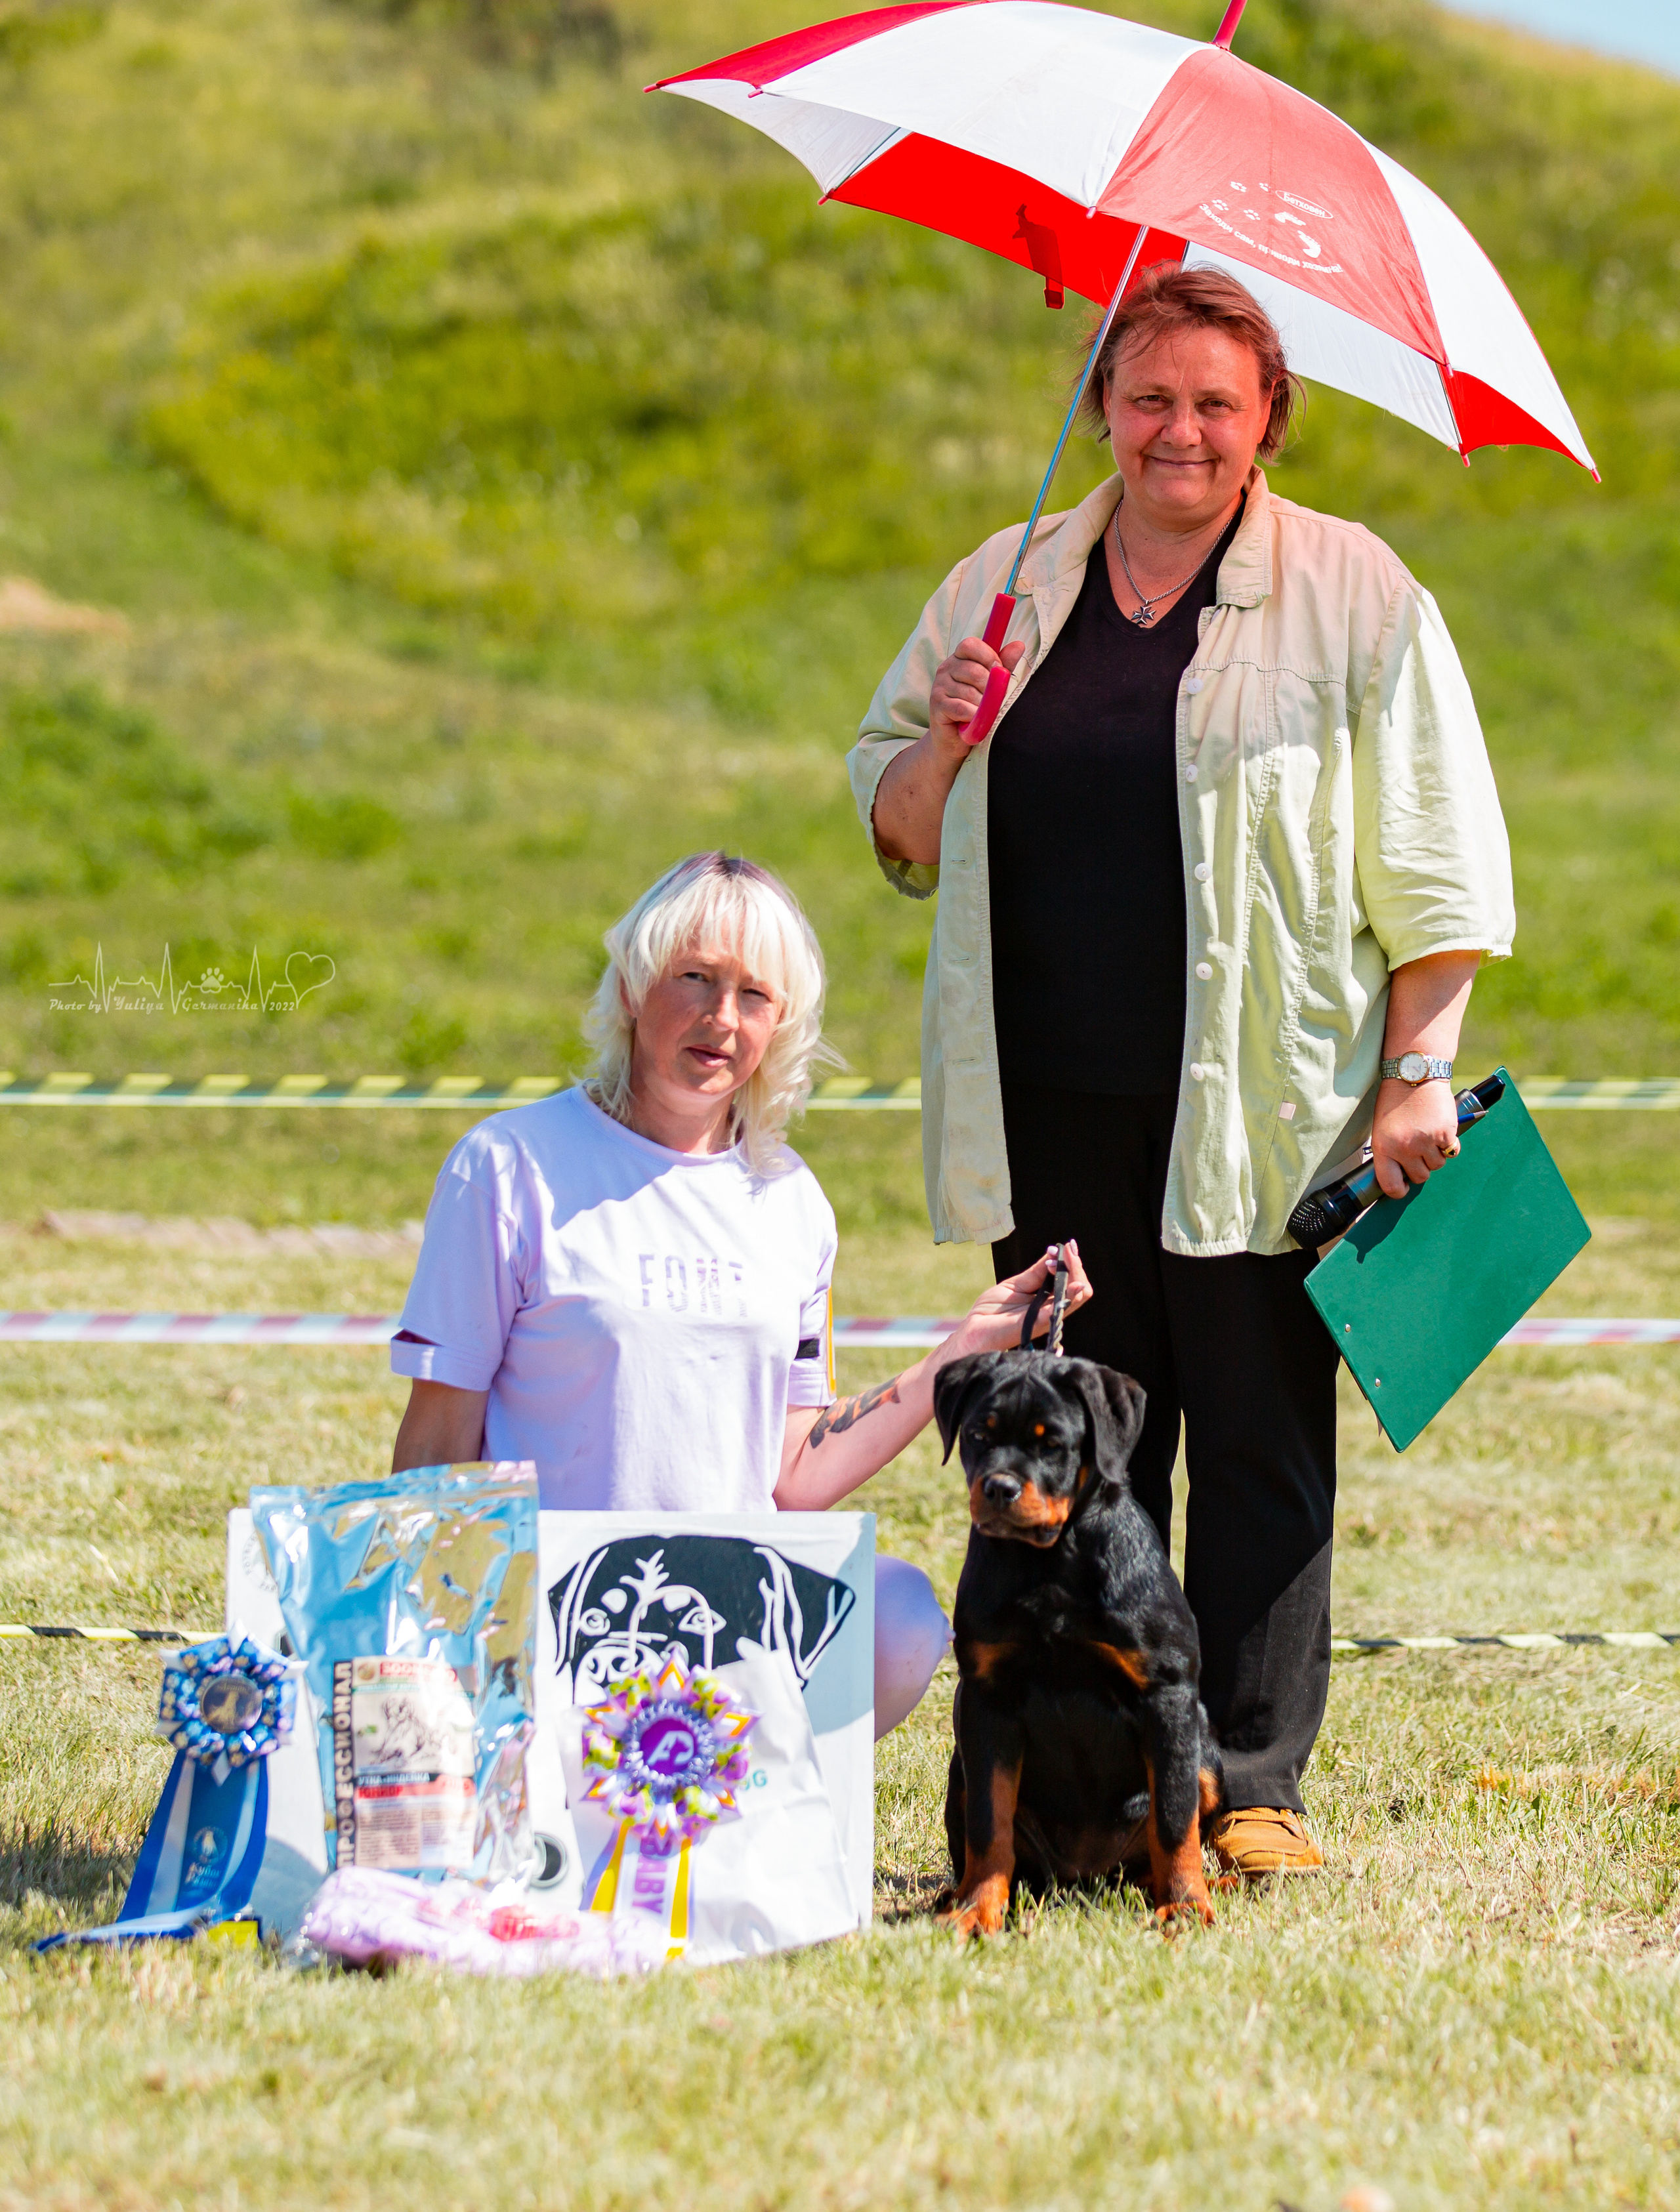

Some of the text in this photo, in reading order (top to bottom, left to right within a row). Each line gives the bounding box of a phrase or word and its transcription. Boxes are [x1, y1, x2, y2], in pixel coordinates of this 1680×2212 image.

[1283, 192, 1326, 218] Бетховен
[1199, 203, 1344, 274] Заходи сам, приводи хозяина!
